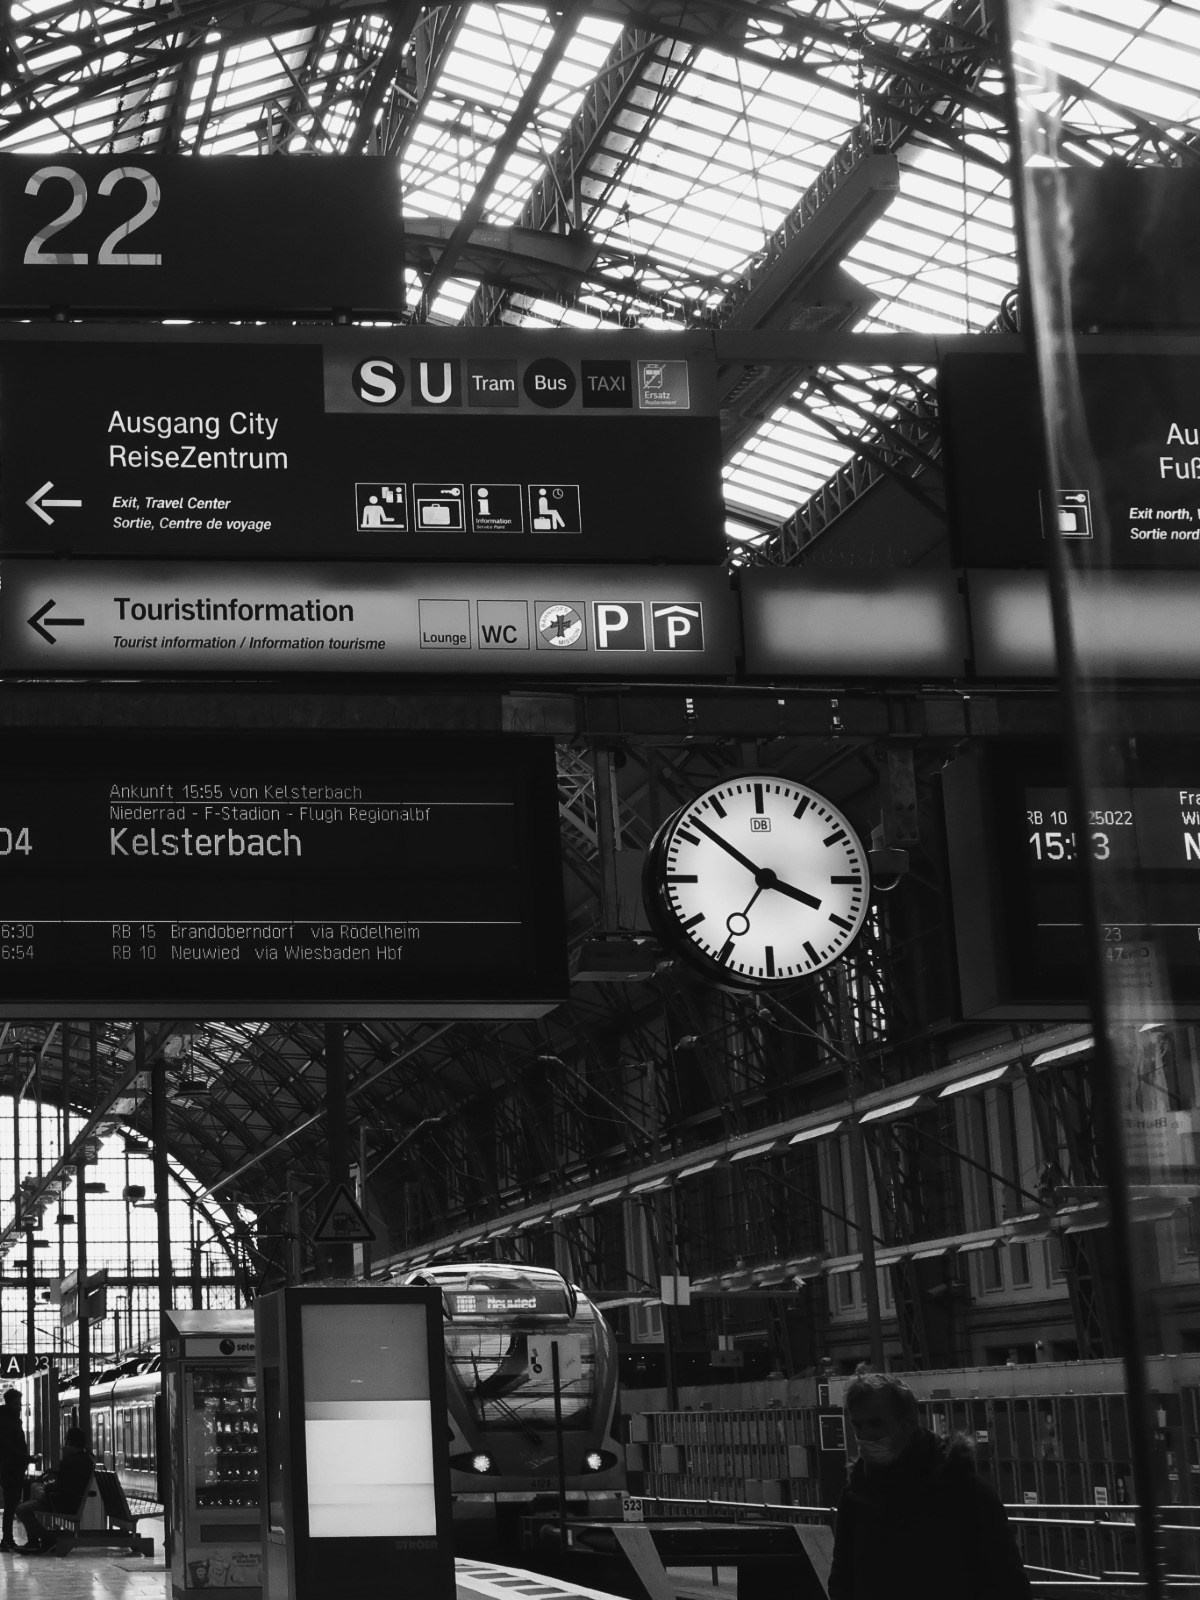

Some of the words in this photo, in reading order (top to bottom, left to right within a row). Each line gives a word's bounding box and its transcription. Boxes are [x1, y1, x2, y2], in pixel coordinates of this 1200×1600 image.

[24, 166, 161, 265] 22
[361, 361, 396, 402] S
[420, 363, 451, 403] U
[472, 376, 514, 390] Tram
[535, 375, 566, 390] Bus
[587, 376, 625, 391] TAXI
[645, 391, 670, 401] Ersatz
[108, 411, 219, 439] Ausgang
[230, 412, 278, 440] City
[1167, 423, 1199, 445] Au
[110, 445, 287, 469] ReiseZentrum
[113, 497, 139, 510] Exit,
[146, 496, 185, 509] Travel
[188, 496, 231, 509] Center
[1129, 507, 1153, 519] Exit
[1156, 508, 1193, 521] north,
[113, 517, 154, 530] Sortie,
[160, 518, 202, 529] Centre
[207, 518, 222, 529] de
[227, 521, 271, 532] voyage
[1130, 527, 1167, 540] Sortie
[114, 598, 353, 621] Touristinformation
[598, 605, 628, 647] P
[668, 616, 691, 647] P
[424, 632, 466, 645] Lounge
[482, 625, 517, 643] WC
[114, 636, 157, 648] Tourist
[161, 637, 236, 648] information
[249, 637, 324, 649] Information
[328, 638, 385, 649] tourisme
[109, 784, 173, 798] Ankunft
[182, 784, 222, 798] 15:55
[229, 787, 257, 798] von
[264, 784, 361, 799] Kelsterbach
[110, 805, 185, 819] Niederrad
[205, 806, 279, 820] F-Stadion
[299, 806, 342, 823] Flugh
[349, 807, 430, 823] Regionalbf
[1050, 811, 1067, 825] 10
[754, 820, 767, 829] DB
[110, 827, 301, 856] Kelsterbach
[1029, 832, 1110, 860] 15:3
[112, 924, 130, 938] RB
[138, 924, 155, 938] 15
[171, 924, 293, 938] Brandoberndorf
[310, 924, 333, 938] via
[340, 924, 419, 938] Rödelheim
[112, 945, 130, 959] RB
[139, 945, 156, 959] 10
[171, 945, 239, 959] Neuwied
[254, 945, 277, 959] via
[284, 945, 369, 959] Wiesbaden
[376, 945, 402, 959] Hbf
[7, 1356, 20, 1373] A
[624, 1500, 642, 1511] 523
